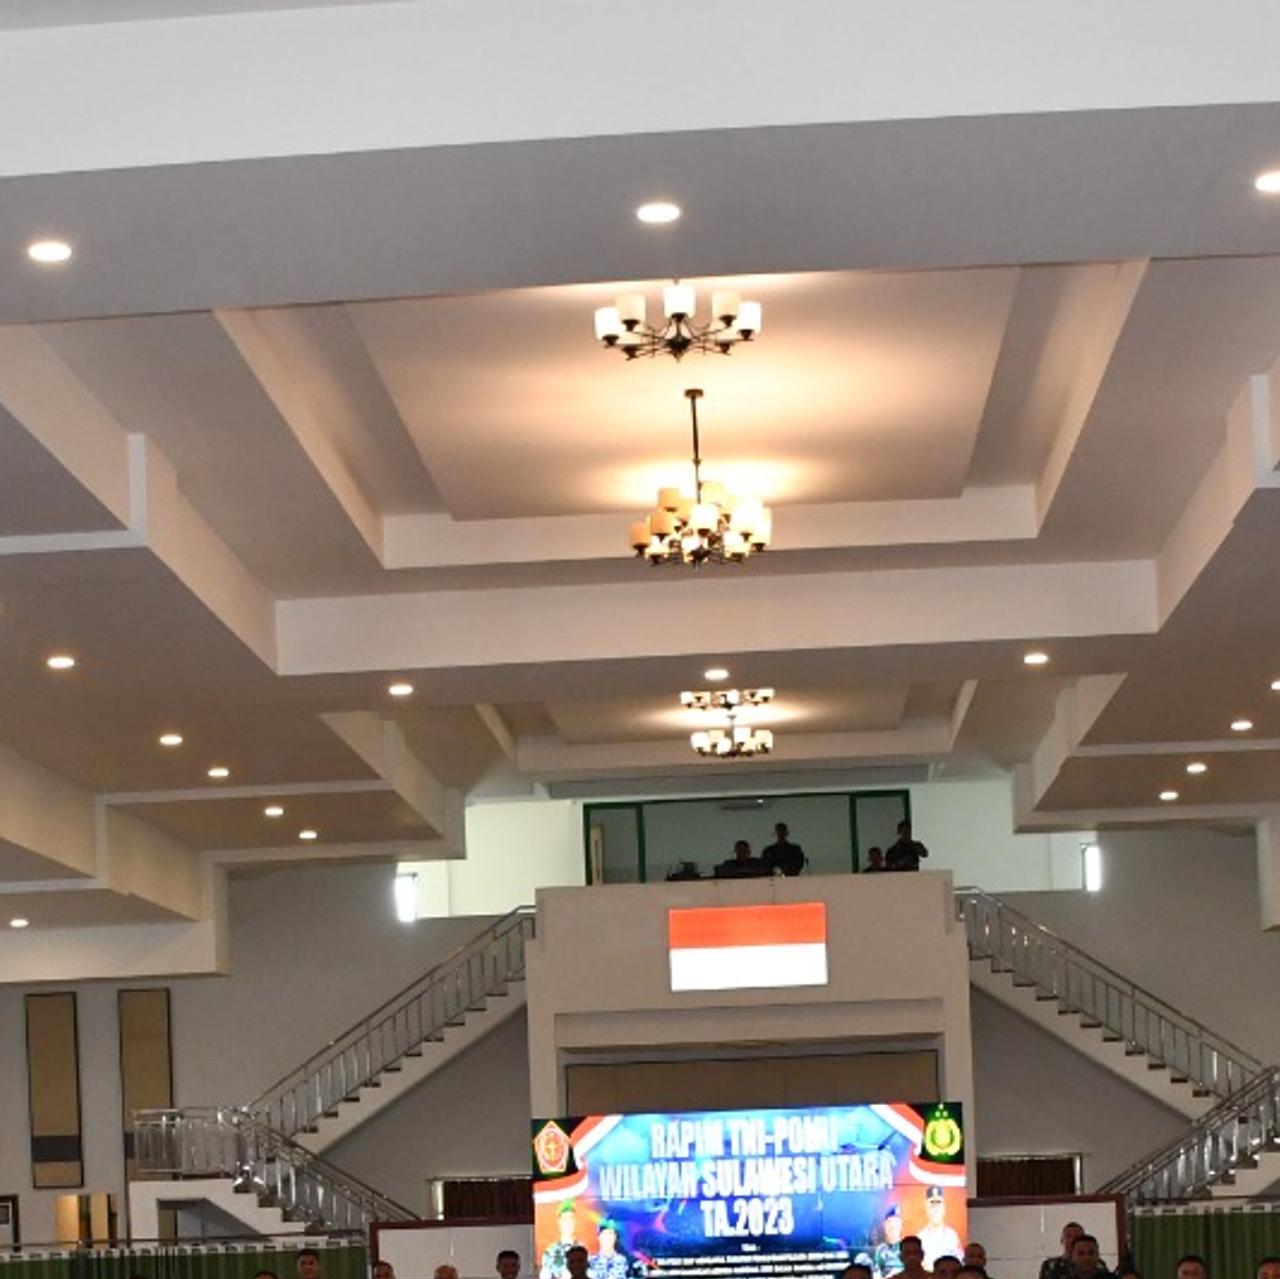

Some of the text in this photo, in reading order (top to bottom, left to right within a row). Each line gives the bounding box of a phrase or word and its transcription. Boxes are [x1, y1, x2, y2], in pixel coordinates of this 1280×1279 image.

[651, 1119, 724, 1158] RAPIM
[599, 1150, 894, 1200] WILAYAH SULAWESI UTARA
[700, 1197, 794, 1237] TA.2023
